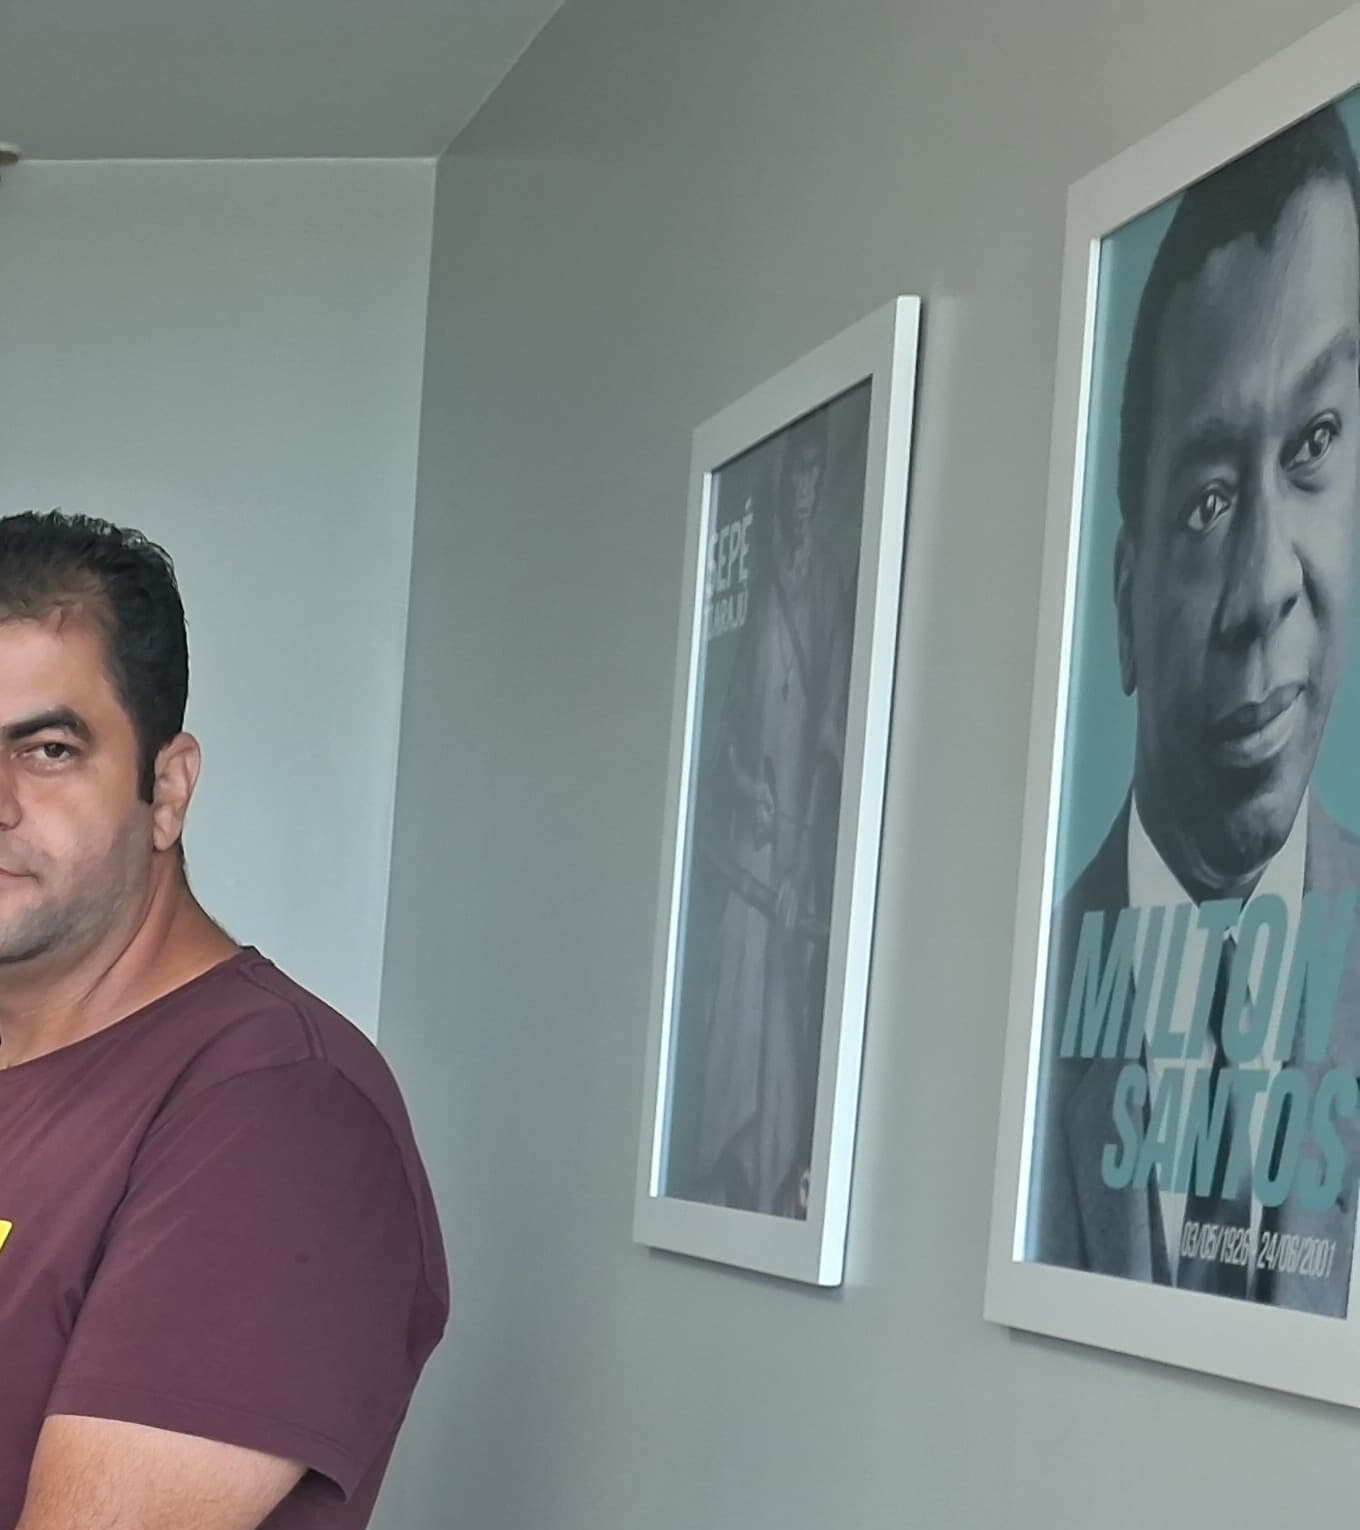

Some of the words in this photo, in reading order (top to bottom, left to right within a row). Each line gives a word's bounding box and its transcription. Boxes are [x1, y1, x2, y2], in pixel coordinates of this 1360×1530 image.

[1060, 891, 1360, 1064] MILTON
[1101, 1064, 1360, 1211] SANTOS
[1256, 1231, 1337, 1279] 24/06/2001
